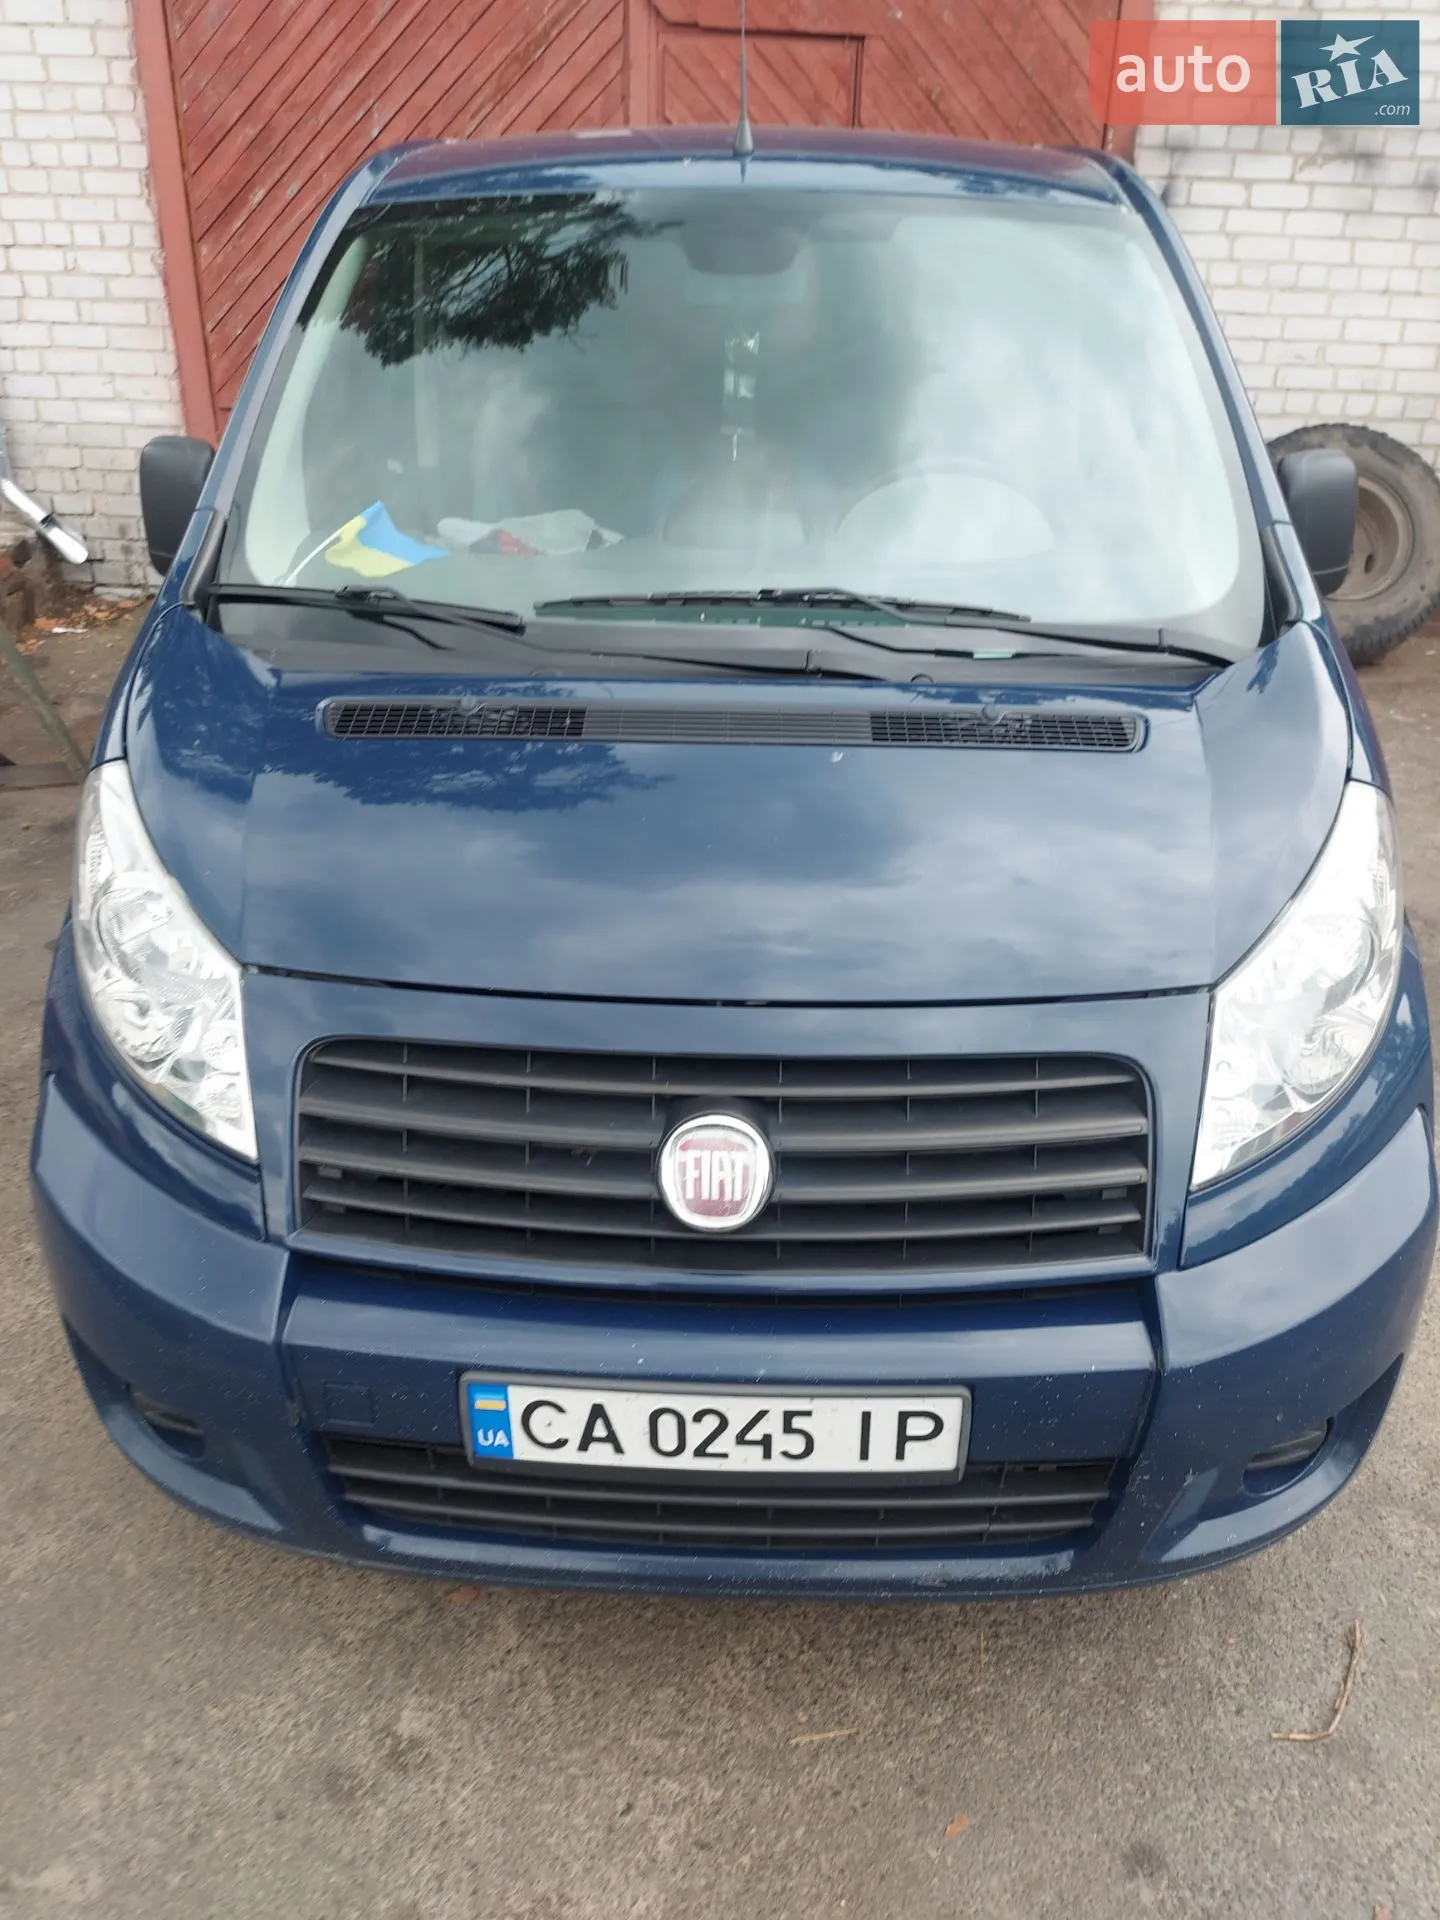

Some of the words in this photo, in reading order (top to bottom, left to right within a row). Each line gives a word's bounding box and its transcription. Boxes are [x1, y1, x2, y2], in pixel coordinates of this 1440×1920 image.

[678, 1148, 750, 1201] FIAT
[476, 1428, 510, 1449] UA
[520, 1400, 624, 1454] CA
[648, 1407, 815, 1460] 0245
[859, 1410, 944, 1461] IP
